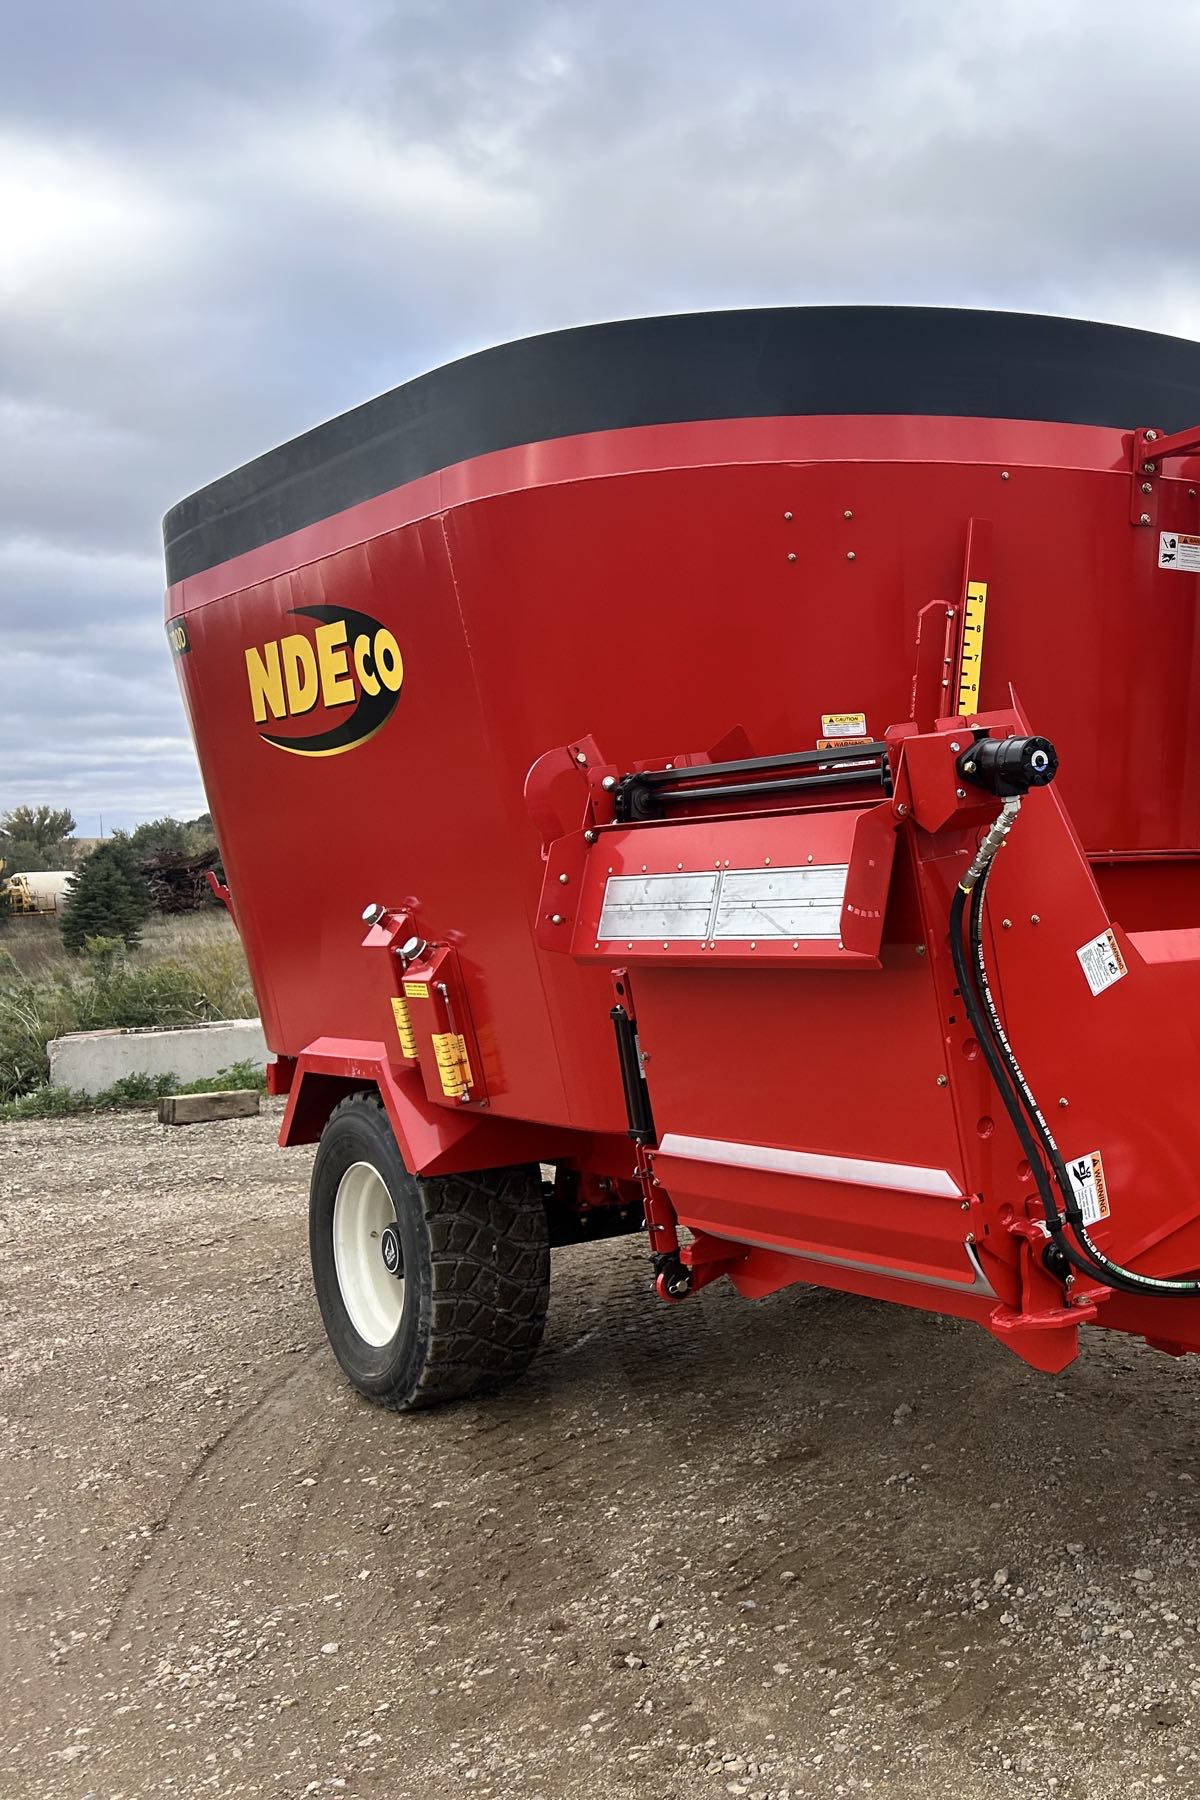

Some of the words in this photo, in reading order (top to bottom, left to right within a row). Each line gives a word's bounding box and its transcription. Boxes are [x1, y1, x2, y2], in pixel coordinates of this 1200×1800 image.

[978, 594, 984, 603] 9
[976, 624, 982, 633] 8
[974, 654, 979, 663] 7
[971, 683, 977, 692] 6
[1094, 1168, 1107, 1213] WARNING
[1081, 1227, 1108, 1264] PULSAR
